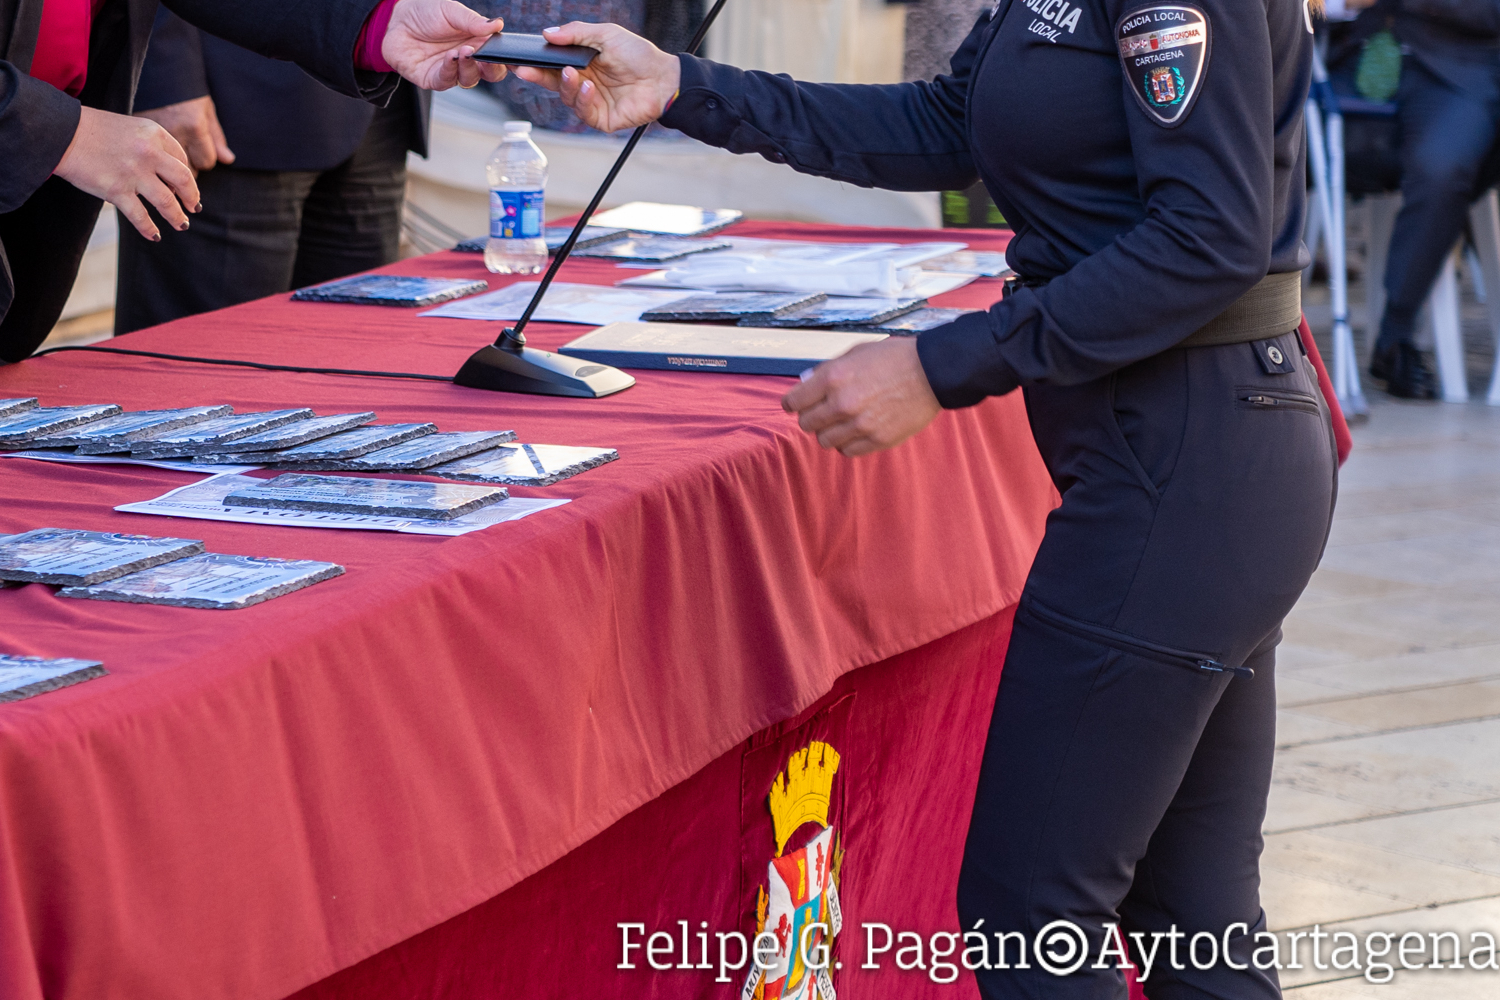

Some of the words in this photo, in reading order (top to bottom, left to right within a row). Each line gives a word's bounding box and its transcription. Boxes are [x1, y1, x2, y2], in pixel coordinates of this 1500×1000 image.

[1028, 18, 1062, 43] LOCAL
[1122, 15, 1151, 34] POLICIA
[1154, 12, 1186, 22] LOCAL
[1135, 49, 1184, 66] CARTAGENA
